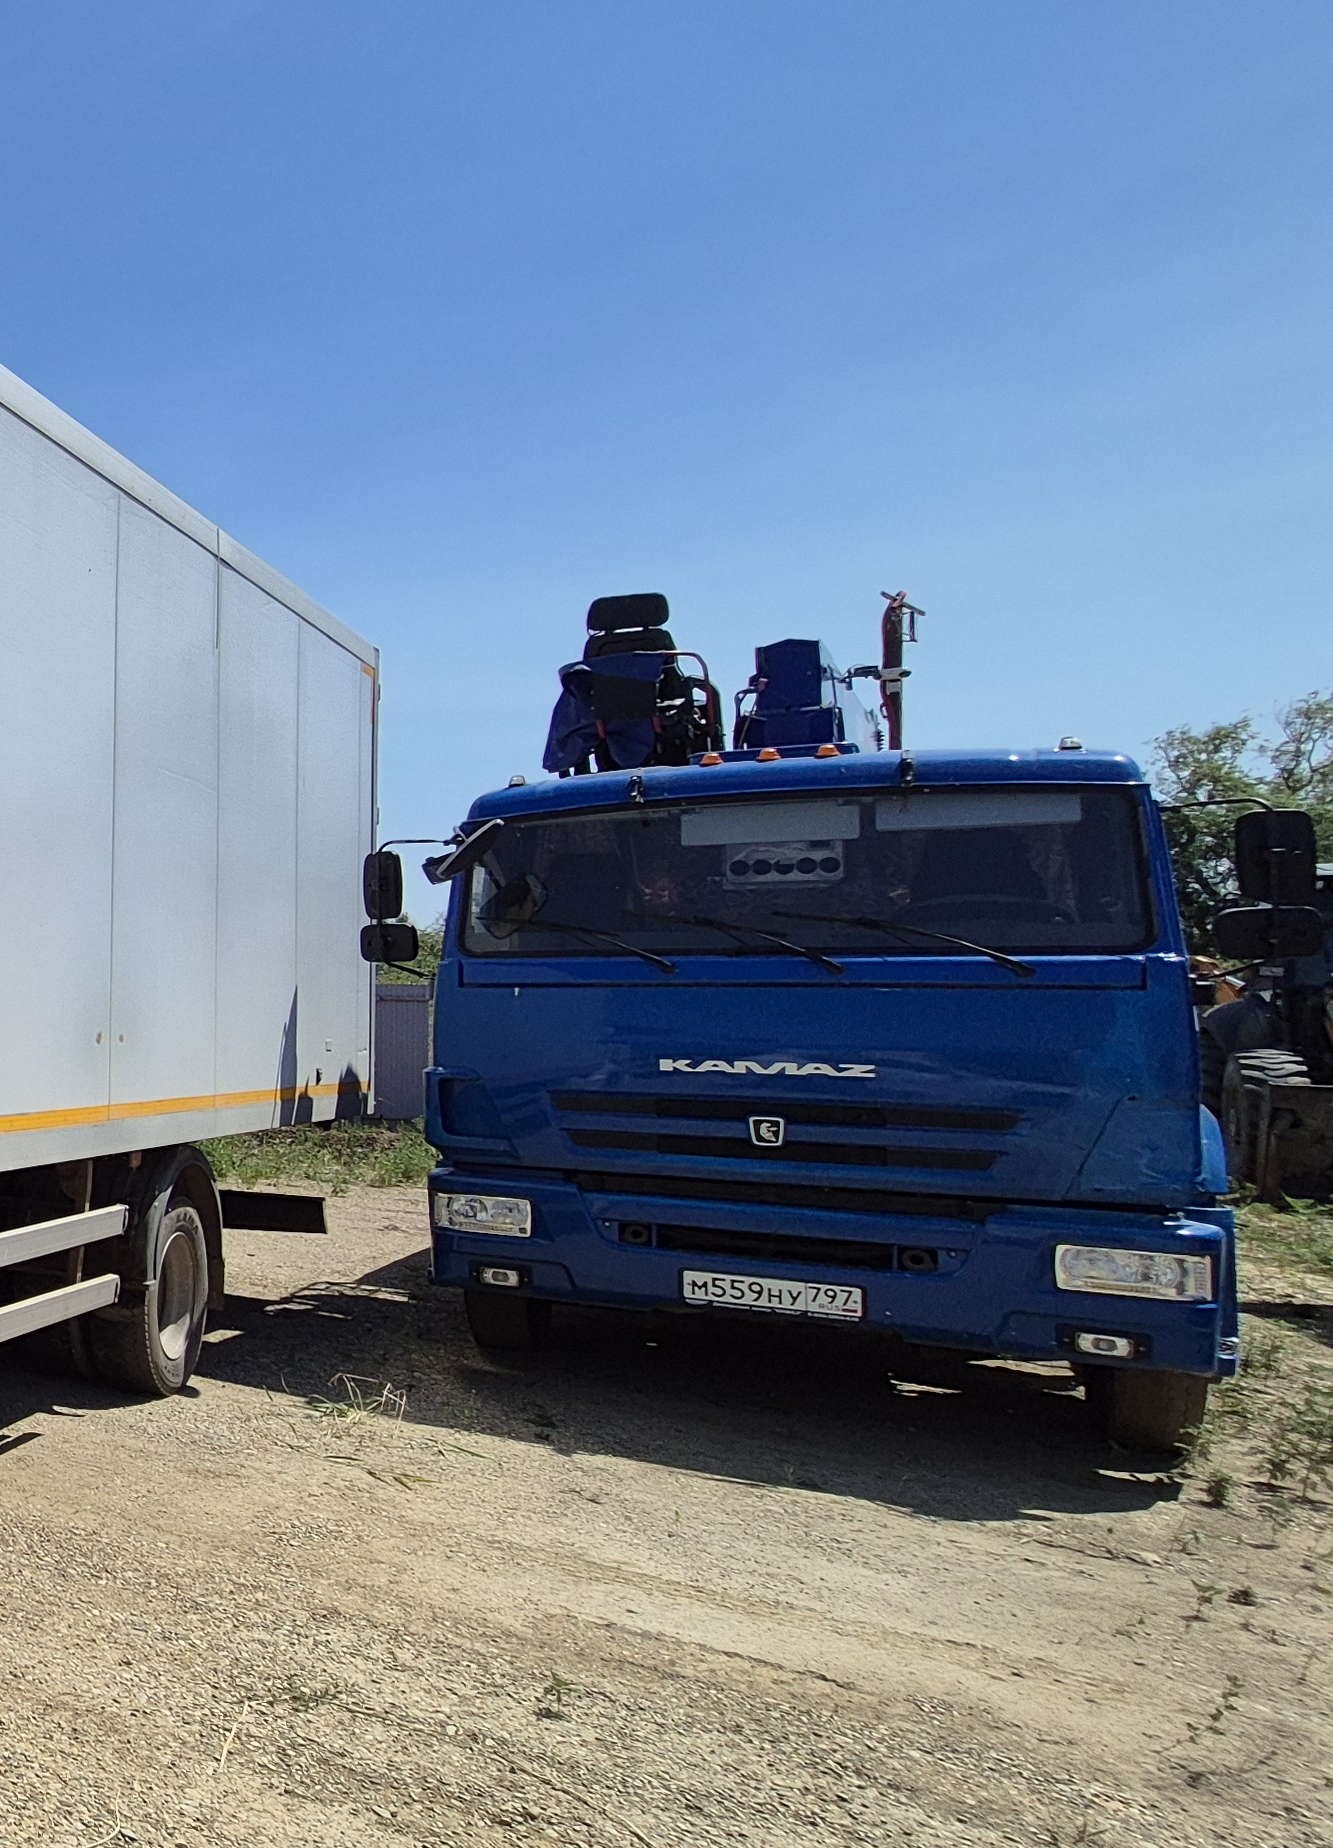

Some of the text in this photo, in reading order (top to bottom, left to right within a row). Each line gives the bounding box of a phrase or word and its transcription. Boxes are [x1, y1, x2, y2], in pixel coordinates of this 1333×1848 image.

[658, 1058, 877, 1078] KAMAZ
[690, 1277, 854, 1307] М559НУ 797
[817, 1303, 842, 1313] RUS
